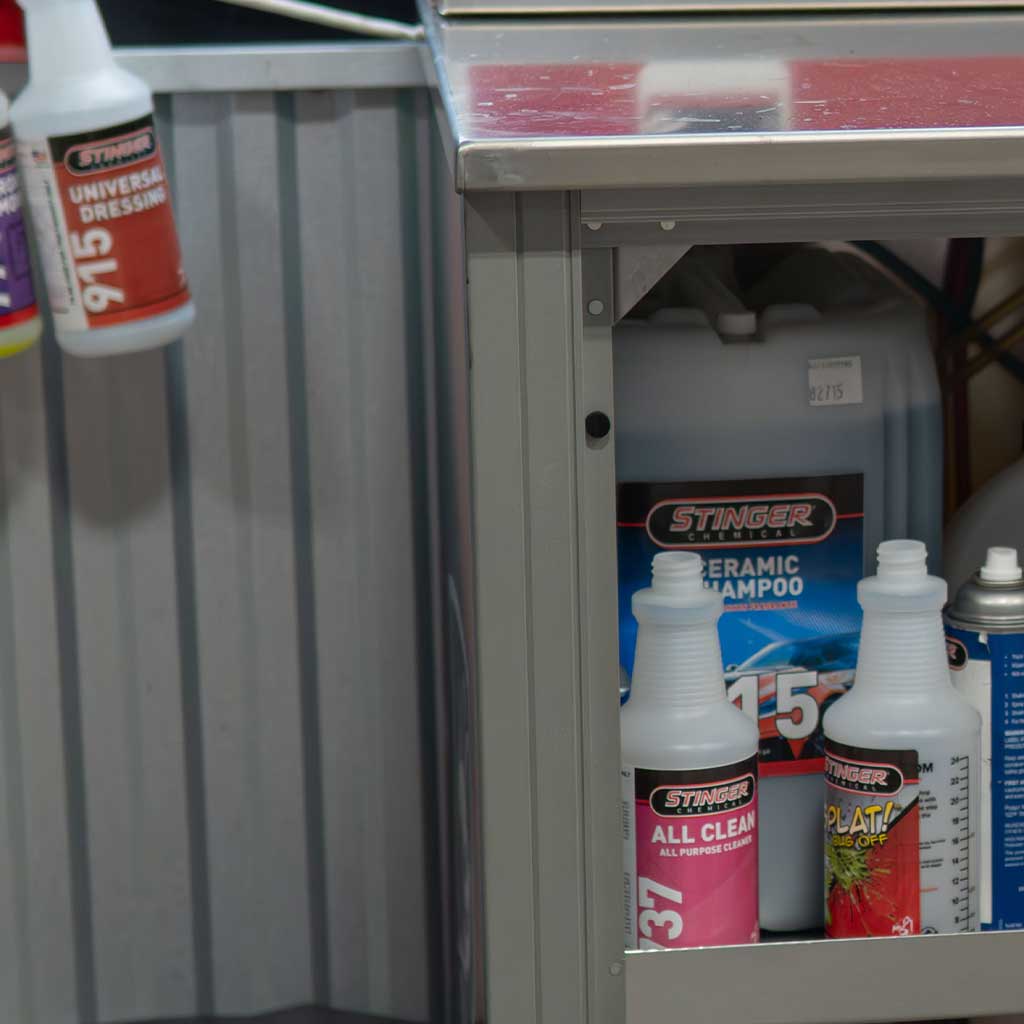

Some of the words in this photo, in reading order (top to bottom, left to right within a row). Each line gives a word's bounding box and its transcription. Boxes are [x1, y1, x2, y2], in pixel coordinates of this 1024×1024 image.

[71, 228, 125, 313] 915
[669, 504, 814, 532] STINGER
[687, 531, 797, 542] CHEMICAL
[727, 669, 819, 740] 15
[665, 780, 750, 807] STINGER
[651, 825, 695, 844] ALL
[701, 811, 756, 842] CLEAN
[826, 801, 894, 835] PLAT!
[659, 848, 678, 857] ALL
[680, 844, 722, 857] PURPOSE
[723, 835, 753, 852] CLEANER
[857, 834, 888, 847] OFF
